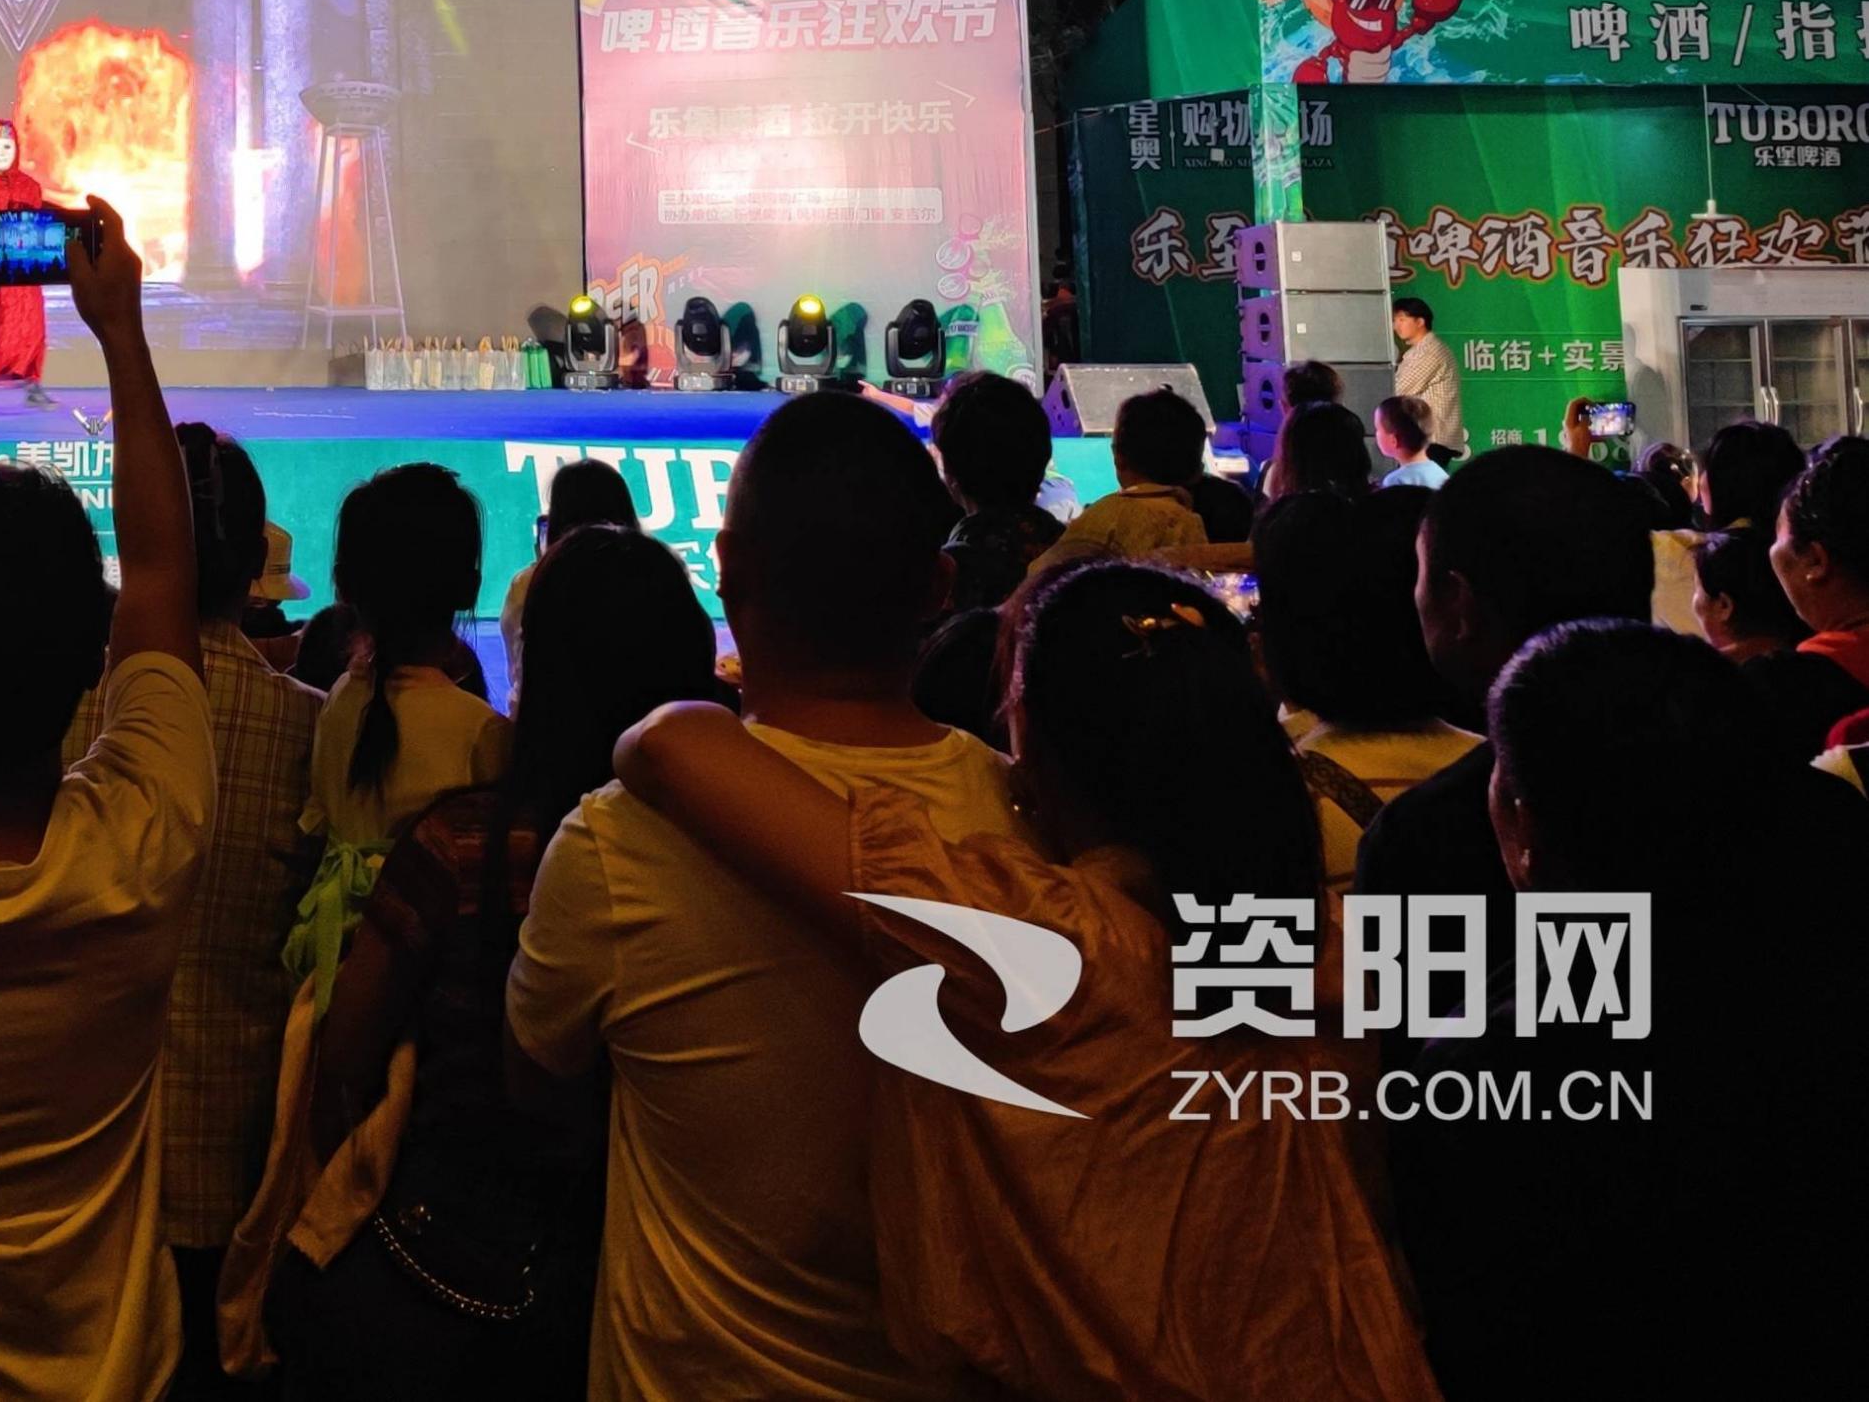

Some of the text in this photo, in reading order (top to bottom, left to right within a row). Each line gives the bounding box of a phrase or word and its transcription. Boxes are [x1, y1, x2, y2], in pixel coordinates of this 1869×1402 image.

[1569, 1, 1869, 66] 啤酒/指
[801, 100, 956, 136] 拉开快乐
[1129, 101, 1161, 170] 星奥
[1181, 100, 1334, 146] 购物场
[1754, 146, 1841, 167] 乐堡啤酒
